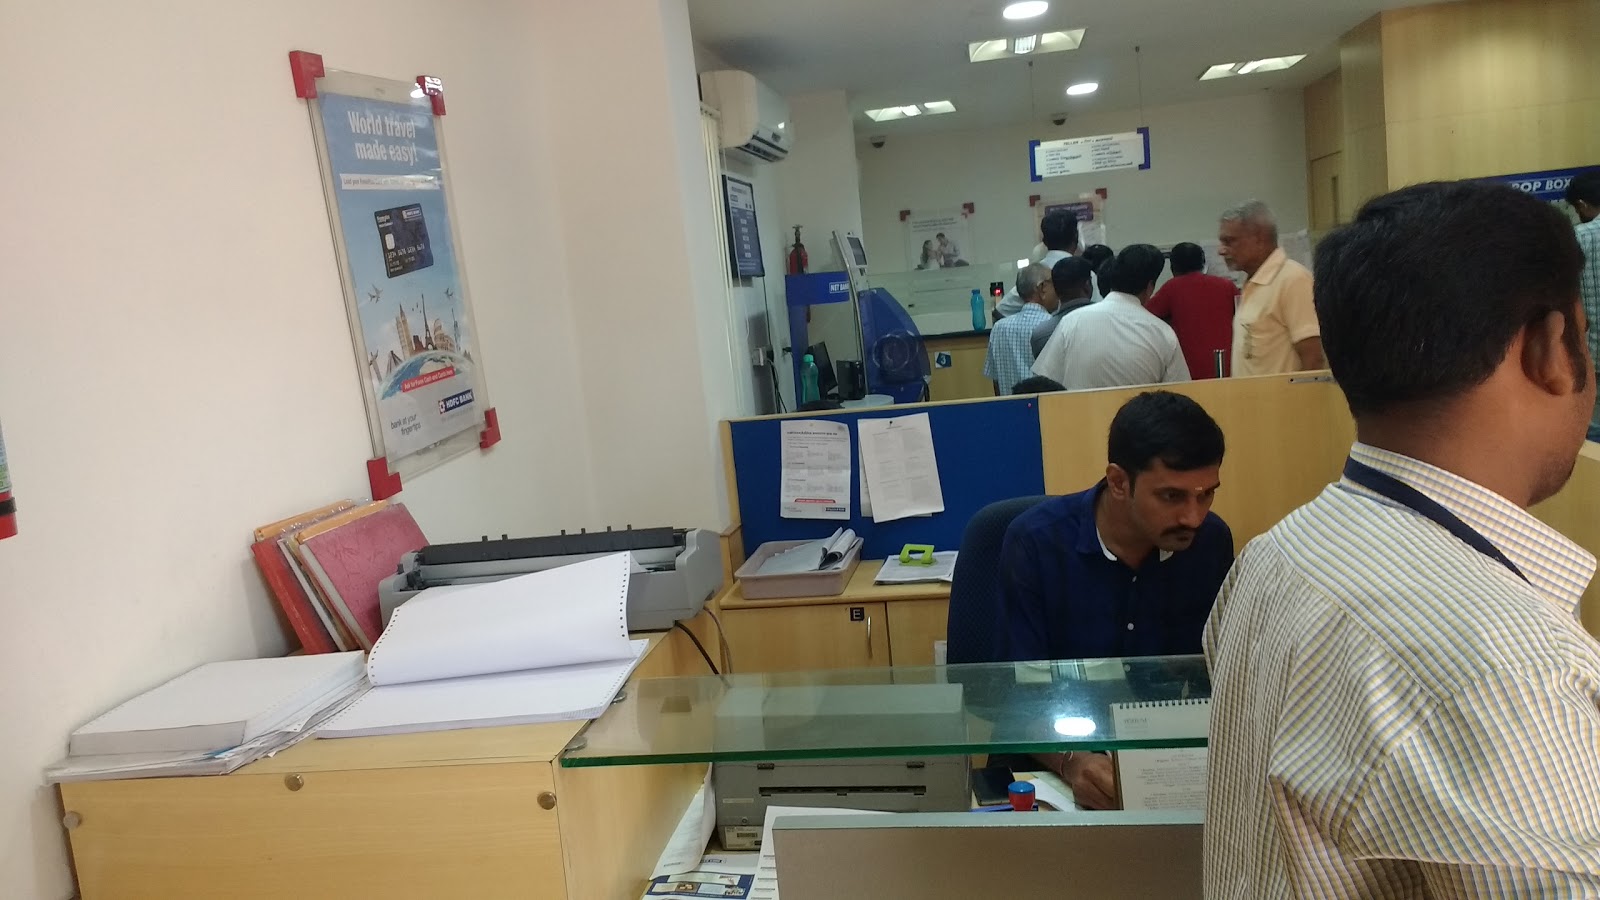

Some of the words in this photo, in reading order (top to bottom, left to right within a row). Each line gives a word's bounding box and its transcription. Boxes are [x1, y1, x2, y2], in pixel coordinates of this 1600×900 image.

[347, 111, 383, 135] World
[384, 115, 416, 138] travel
[355, 140, 388, 161] made
[389, 143, 418, 166] easy!
[1545, 178, 1572, 191] BOX
[446, 397, 459, 408] HDFC
[460, 392, 473, 403] BANK
[391, 418, 402, 429] bank
[407, 414, 417, 425] your
[401, 422, 421, 435] fingertips
[853, 609, 861, 620] E
